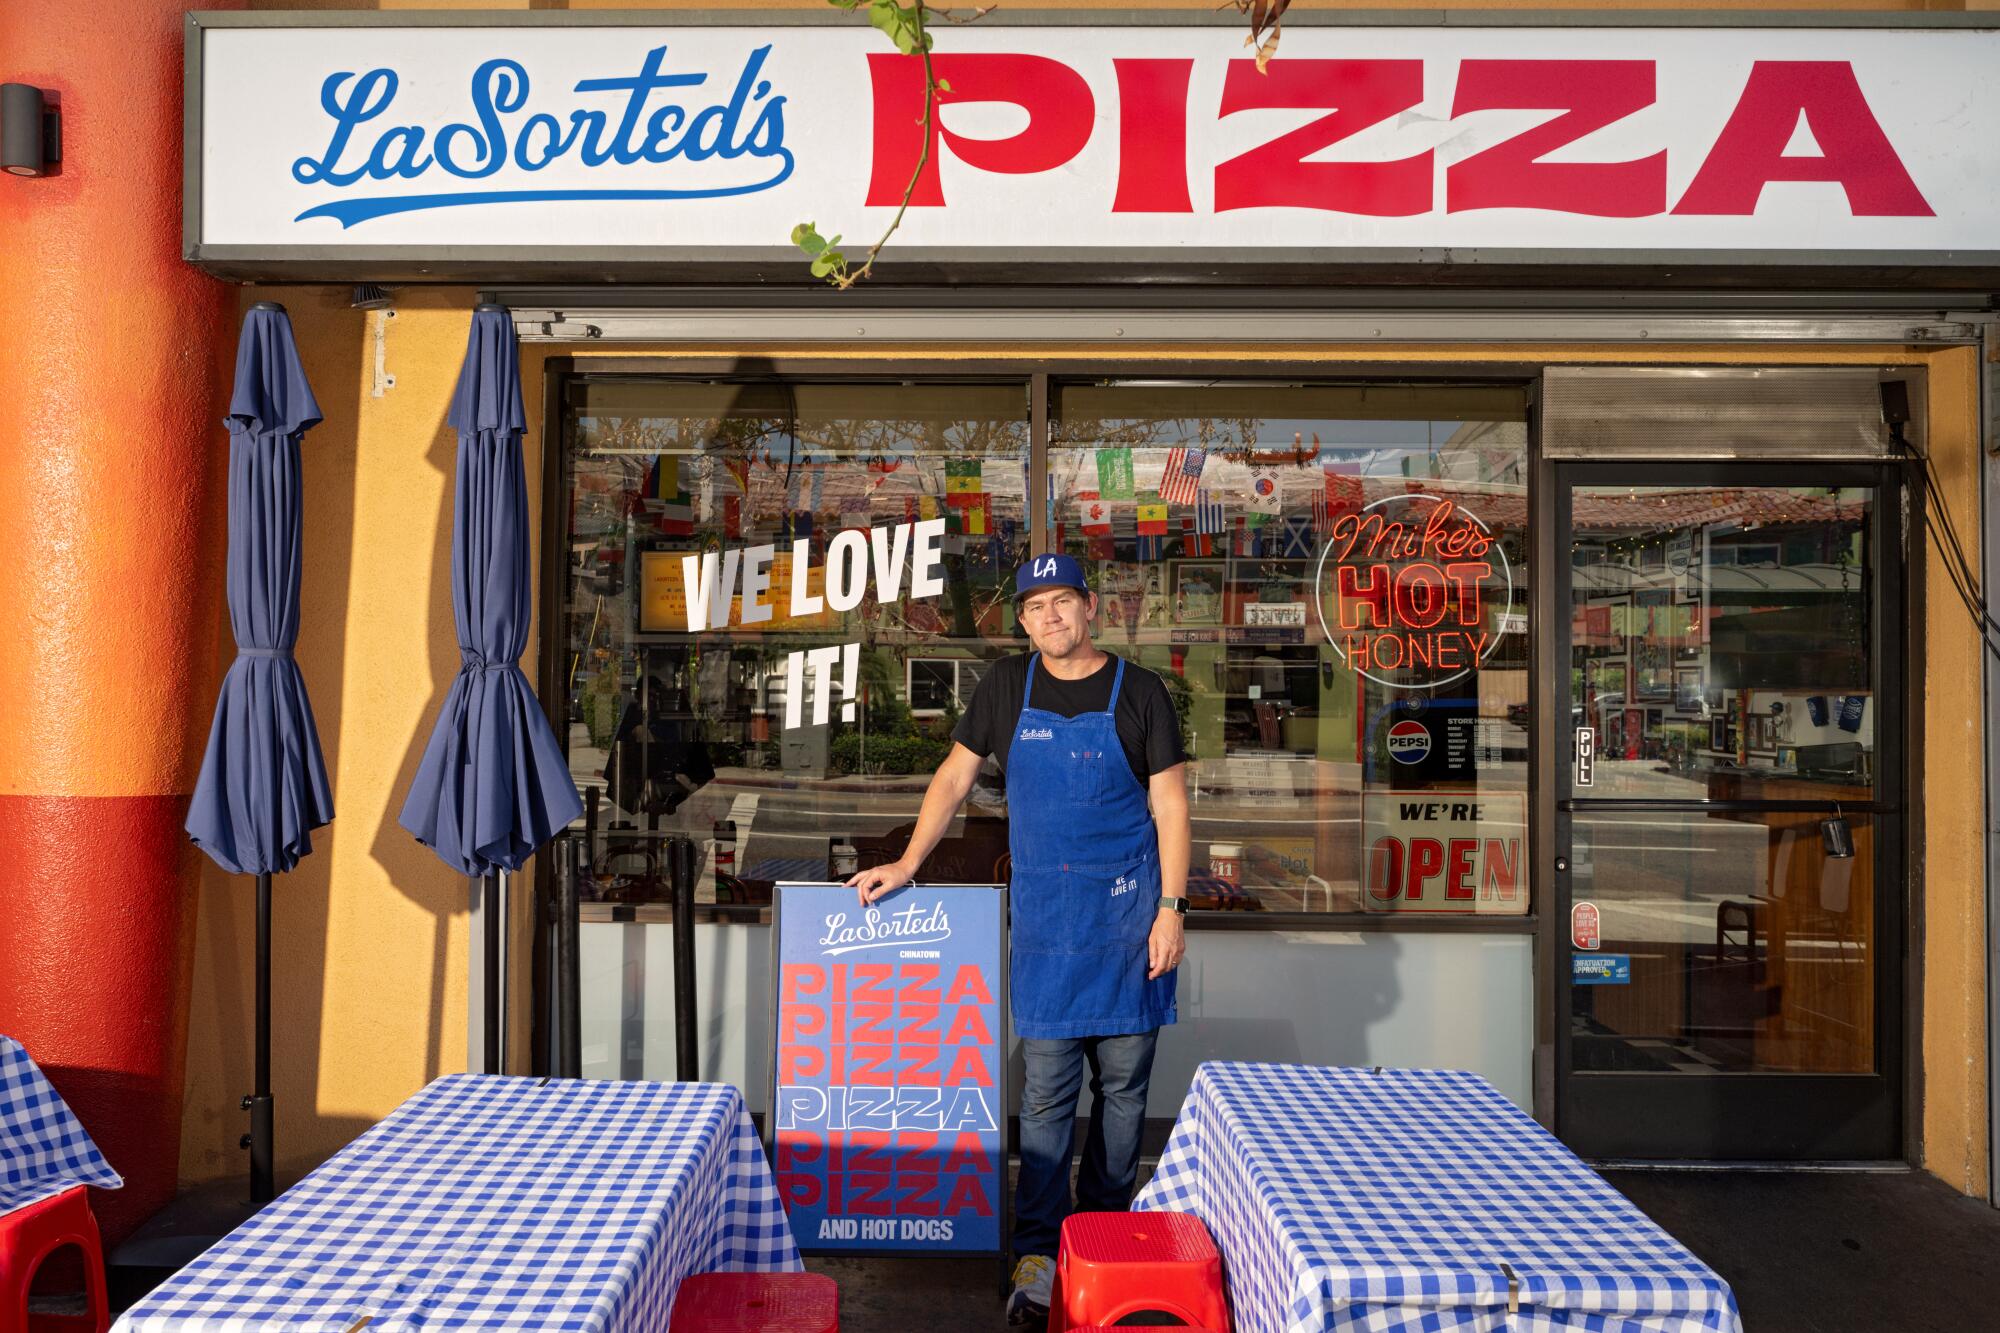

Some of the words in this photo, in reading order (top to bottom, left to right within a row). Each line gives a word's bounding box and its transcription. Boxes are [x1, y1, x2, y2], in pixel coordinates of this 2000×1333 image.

[291, 44, 795, 229] LaSorted's
[865, 53, 1937, 217] PIZZA
[1333, 500, 1494, 563] Mike's
[682, 544, 775, 632] WE
[790, 518, 945, 617] LOVE
[1034, 558, 1057, 577] LA
[1338, 563, 1491, 629] HOT
[1347, 631, 1488, 670] HONEY
[785, 643, 861, 730] IT!
[1389, 738, 1428, 747] PEPSI
[1580, 731, 1591, 783] PULL
[1400, 803, 1486, 821] WE'RE
[1115, 875, 1126, 886] WE
[1369, 836, 1520, 901] OPEN
[1111, 883, 1128, 897] LOVE
[819, 901, 951, 956] LaSorted's
[900, 950, 940, 958] CHINATOWN
[781, 963, 996, 1004] PIZZA
[780, 1004, 994, 1045] PIZZA
[778, 1045, 994, 1087] PIZZA
[775, 1086, 998, 1131] PIZZA
[776, 1131, 993, 1173] PIZZA
[776, 1173, 994, 1216] PIZZA
[818, 1219, 858, 1240] AND
[861, 1219, 897, 1240] HOT
[900, 1219, 954, 1240] DOGS
